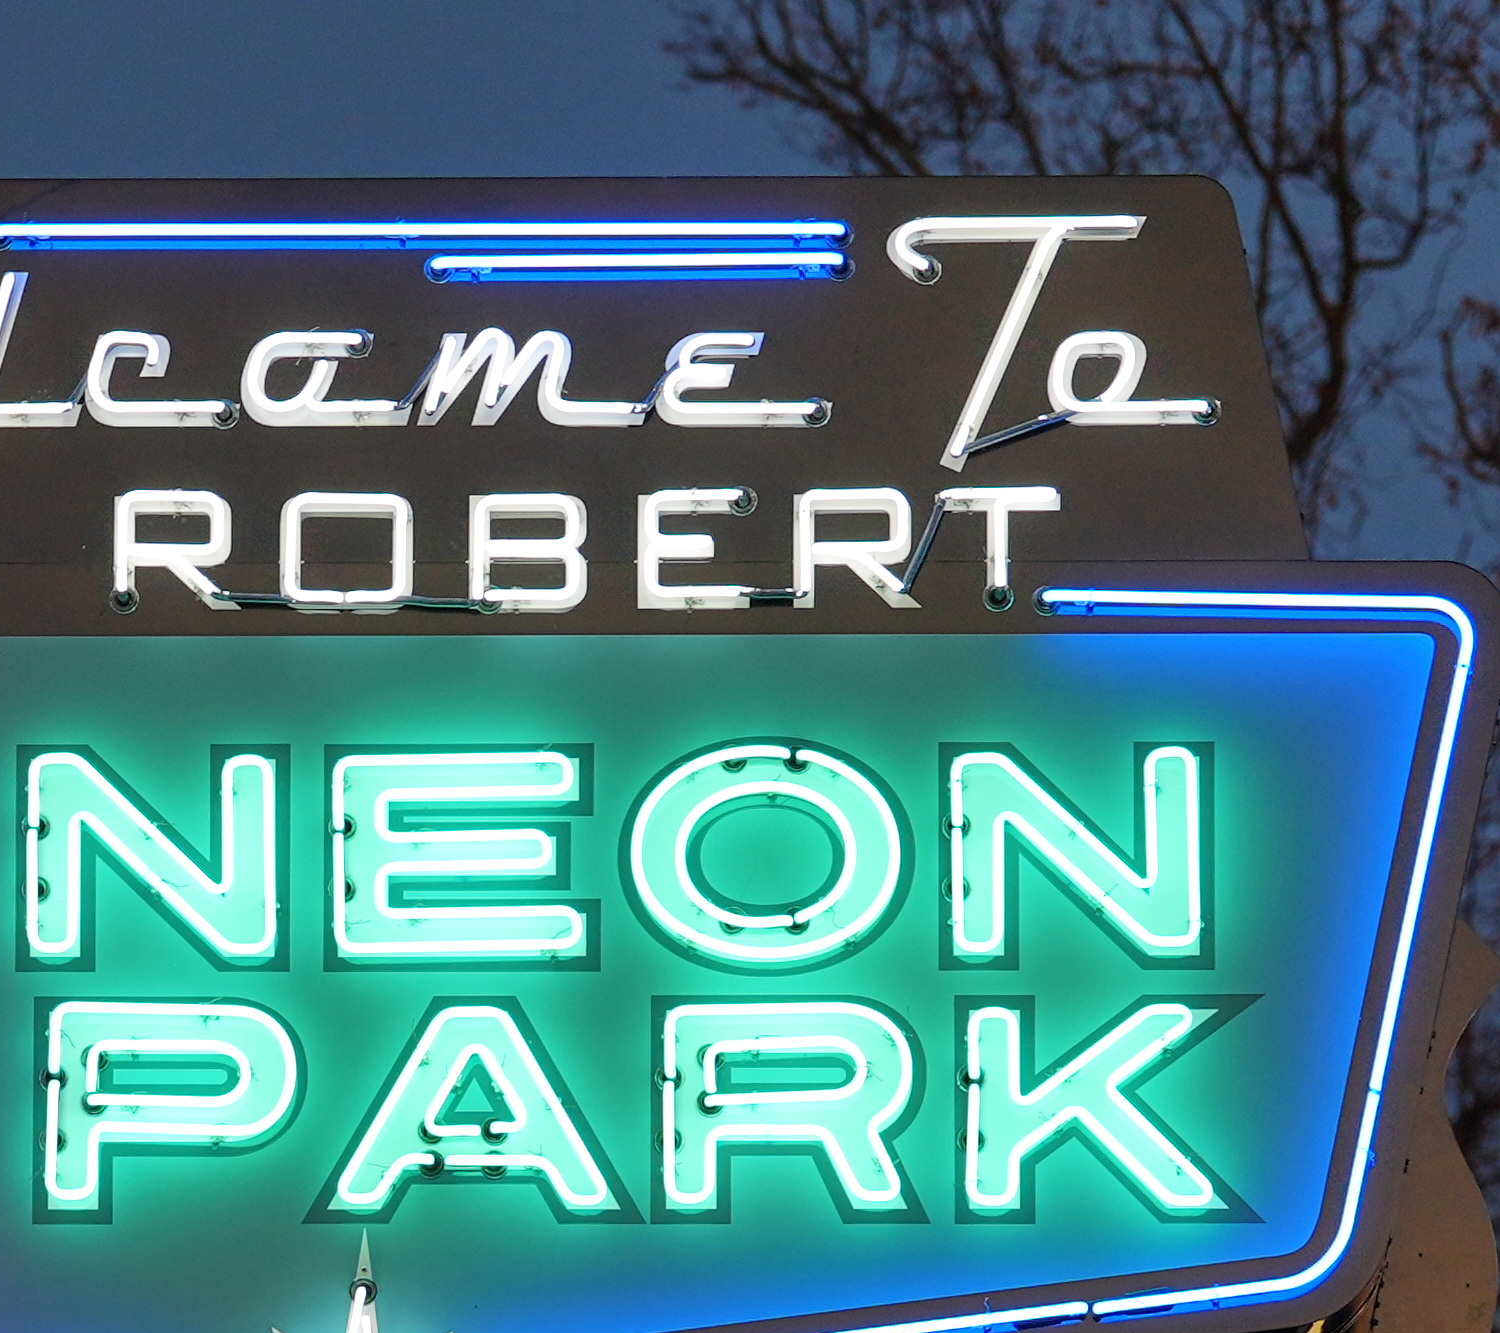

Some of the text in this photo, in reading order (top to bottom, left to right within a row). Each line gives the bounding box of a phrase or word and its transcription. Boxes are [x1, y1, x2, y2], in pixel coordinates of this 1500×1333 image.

[884, 212, 1224, 472] To
[110, 488, 1062, 614] ROBERT
[15, 739, 1214, 972] NEON
[30, 993, 1262, 1226] PARK
